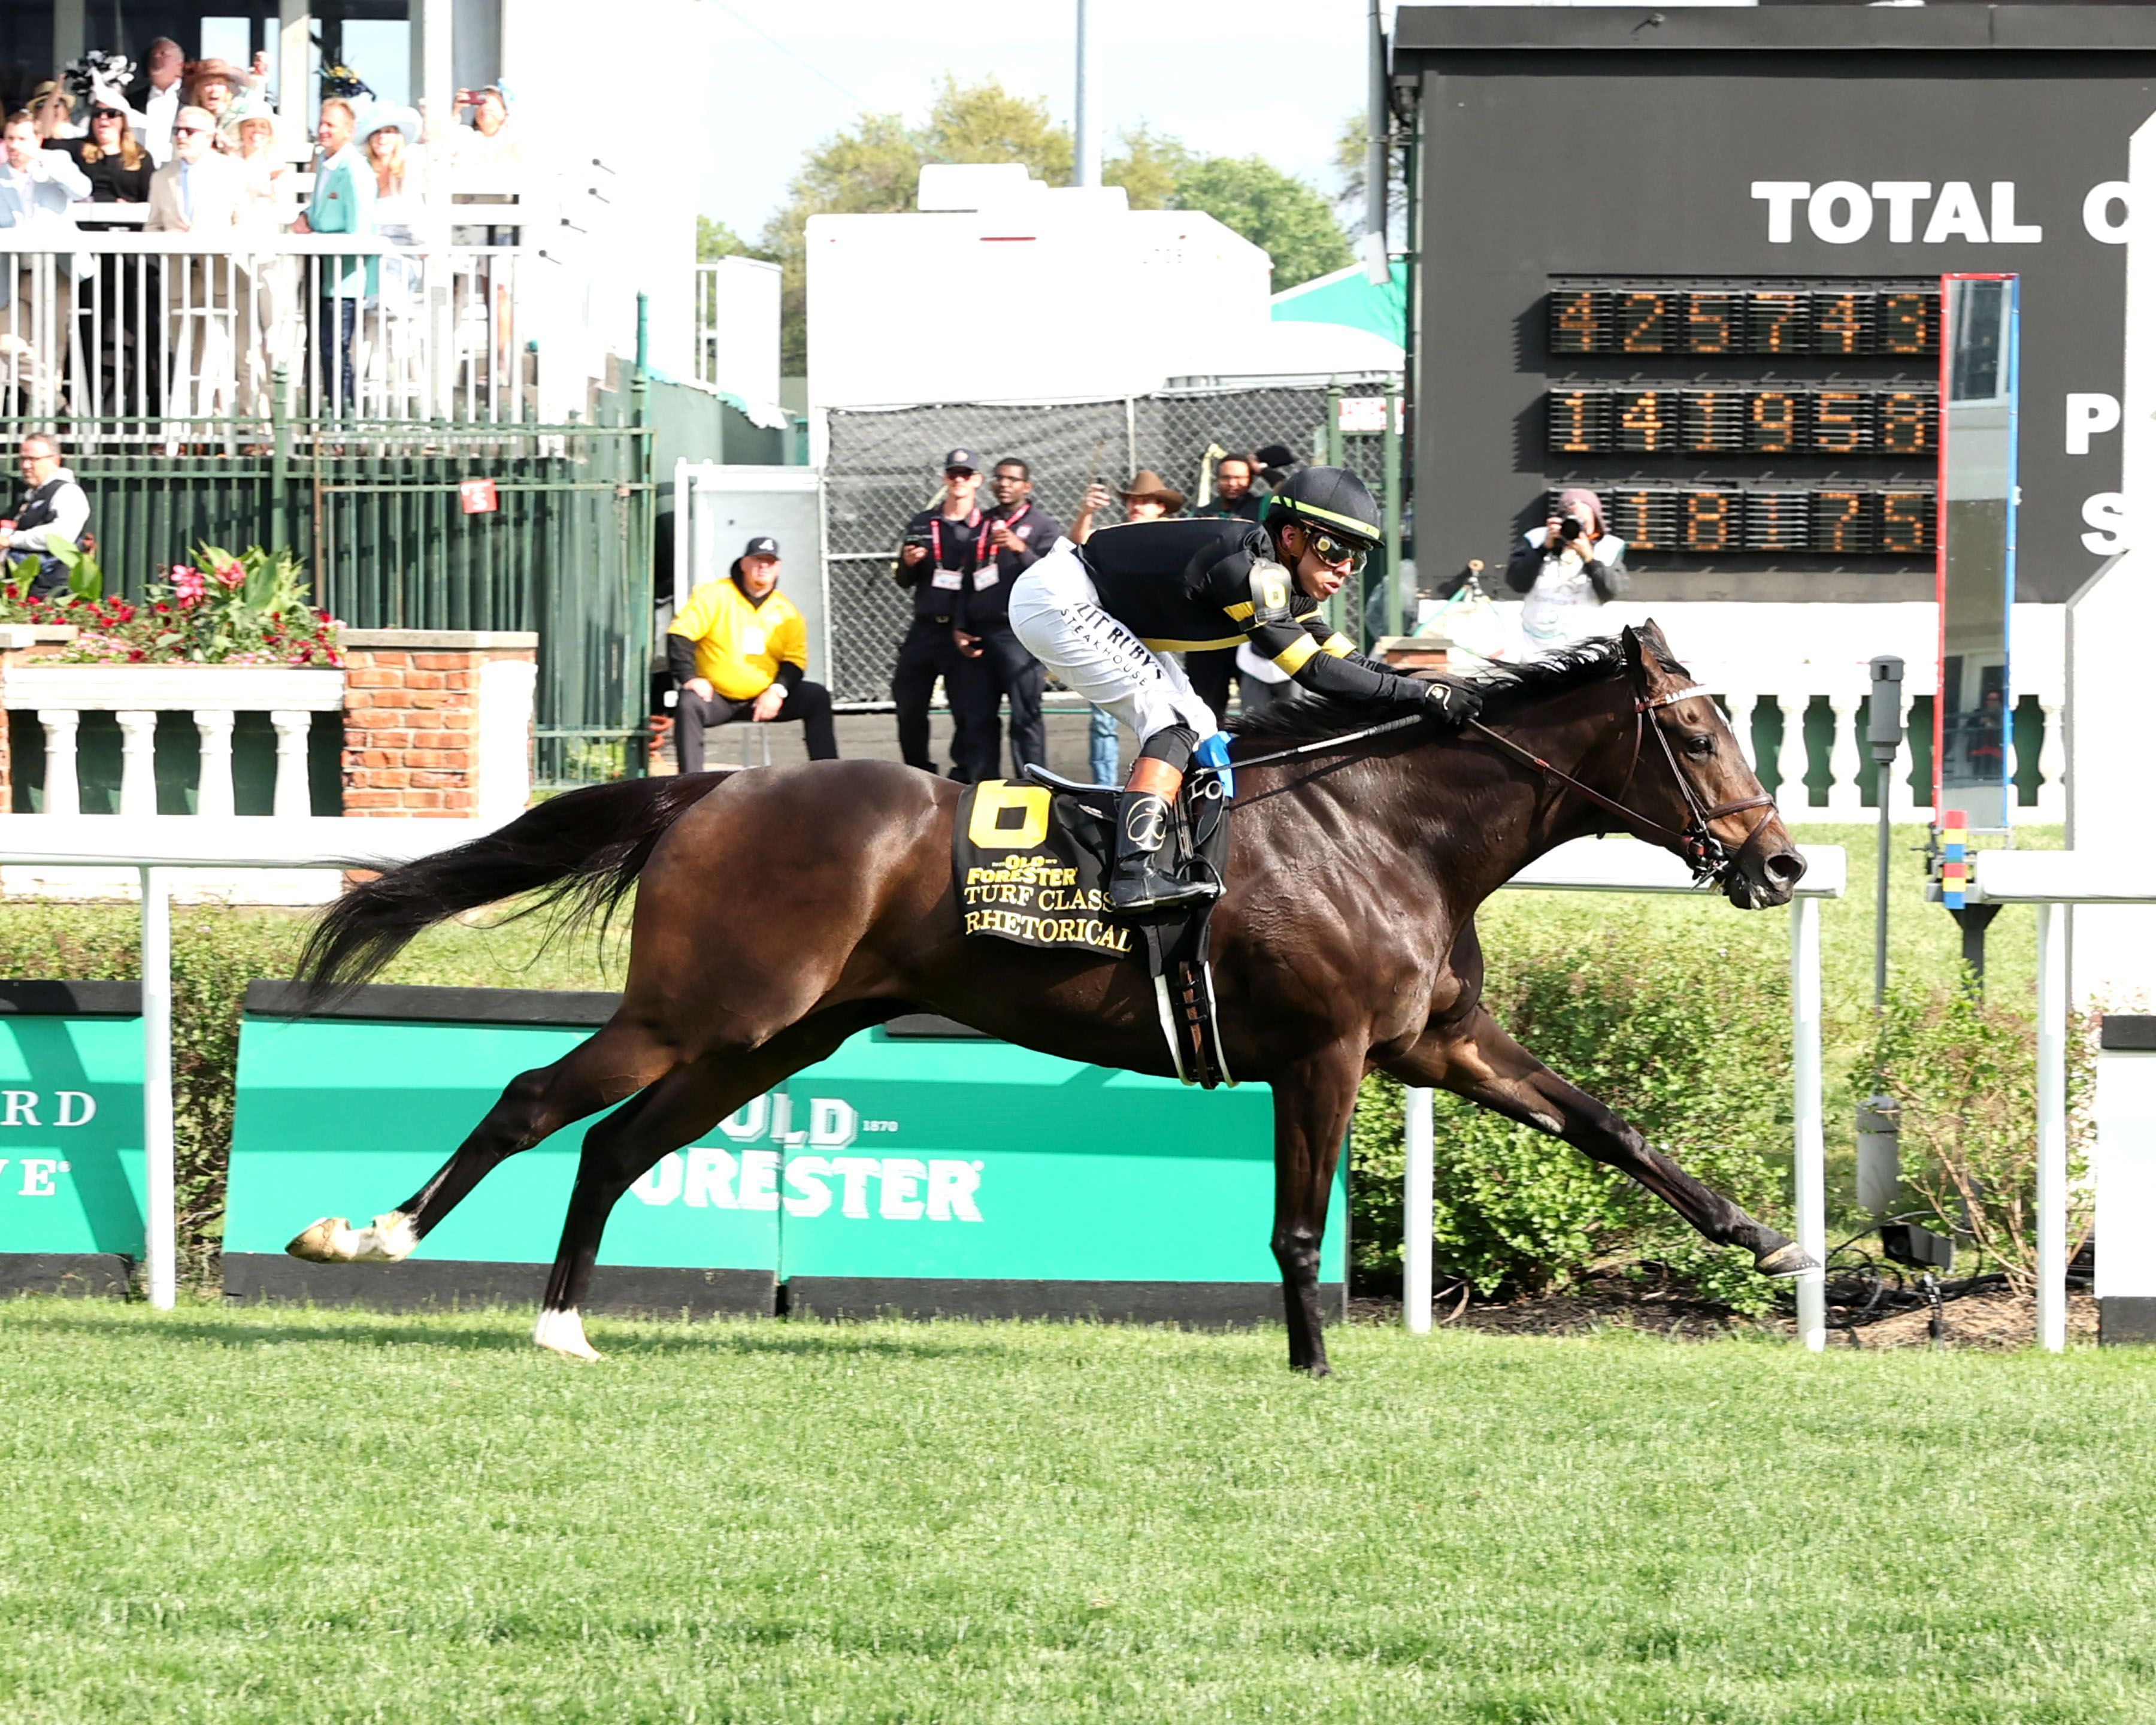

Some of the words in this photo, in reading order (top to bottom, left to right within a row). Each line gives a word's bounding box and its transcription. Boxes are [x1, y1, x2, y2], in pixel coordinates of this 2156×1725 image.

[1751, 181, 2042, 244] TOTAL
[2066, 394, 2121, 455] P
[1260, 568, 1286, 609] 6
[1060, 609, 1148, 686] STEAKHOUSE
[967, 867, 1078, 887] FORESTER
[1005, 854, 1045, 870] OLD
[964, 884, 1034, 906] TURF
[964, 909, 1132, 952] RHETORICAL
[629, 1147, 984, 1222] ORESTER
